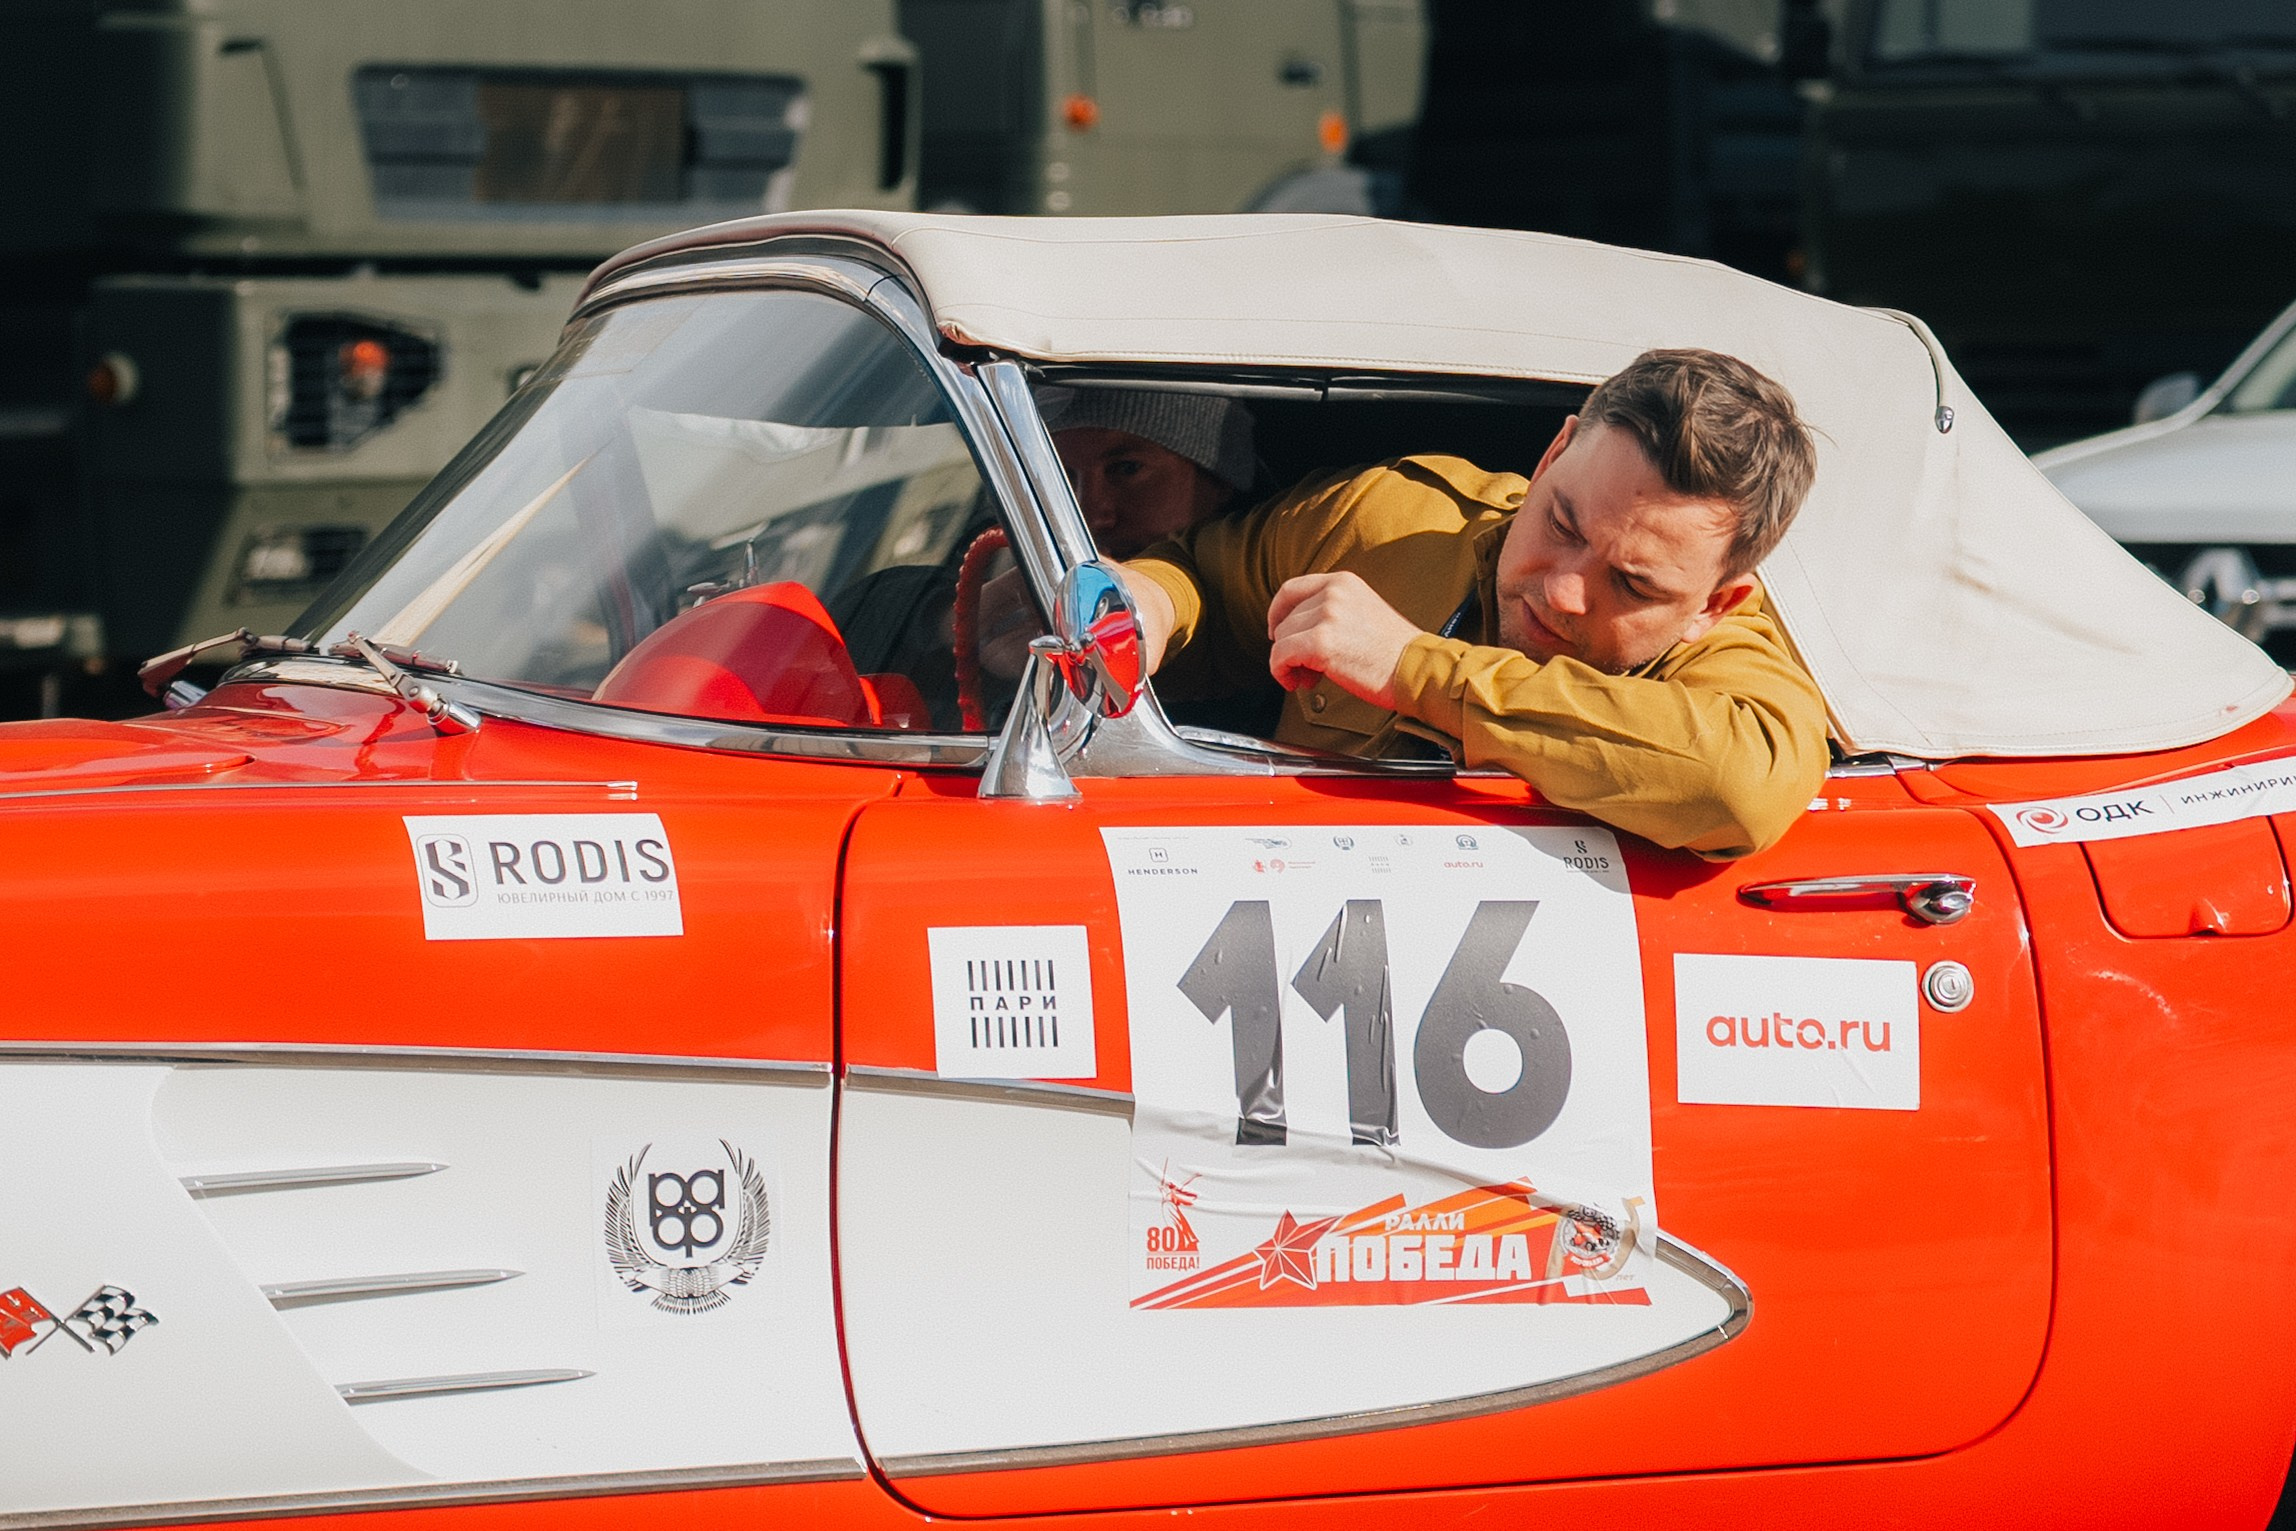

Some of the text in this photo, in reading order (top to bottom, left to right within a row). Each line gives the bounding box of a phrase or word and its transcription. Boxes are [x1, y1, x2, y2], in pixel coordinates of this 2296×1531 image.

[2076, 775, 2296, 822] ОДК ИНЖИНИРИ
[488, 839, 670, 885] RODIS
[1443, 860, 1484, 869] auto.ru
[1563, 857, 1610, 869] RODIS
[1127, 868, 1199, 876] HENDERSON
[497, 890, 589, 904] ЮВЕЛИРНЫЙ
[593, 891, 626, 904] ДОМ
[645, 890, 674, 901] 1997
[970, 995, 1057, 1011] ПАРИ
[1176, 898, 1572, 1149] 116
[1706, 1012, 1891, 1052] auto.ru
[1384, 1212, 1466, 1231] РАЛЛИ
[1146, 1226, 1176, 1252] 80
[1146, 1256, 1200, 1271] ПОБЕДА!
[1316, 1234, 1532, 1282] ПОБЕДА
